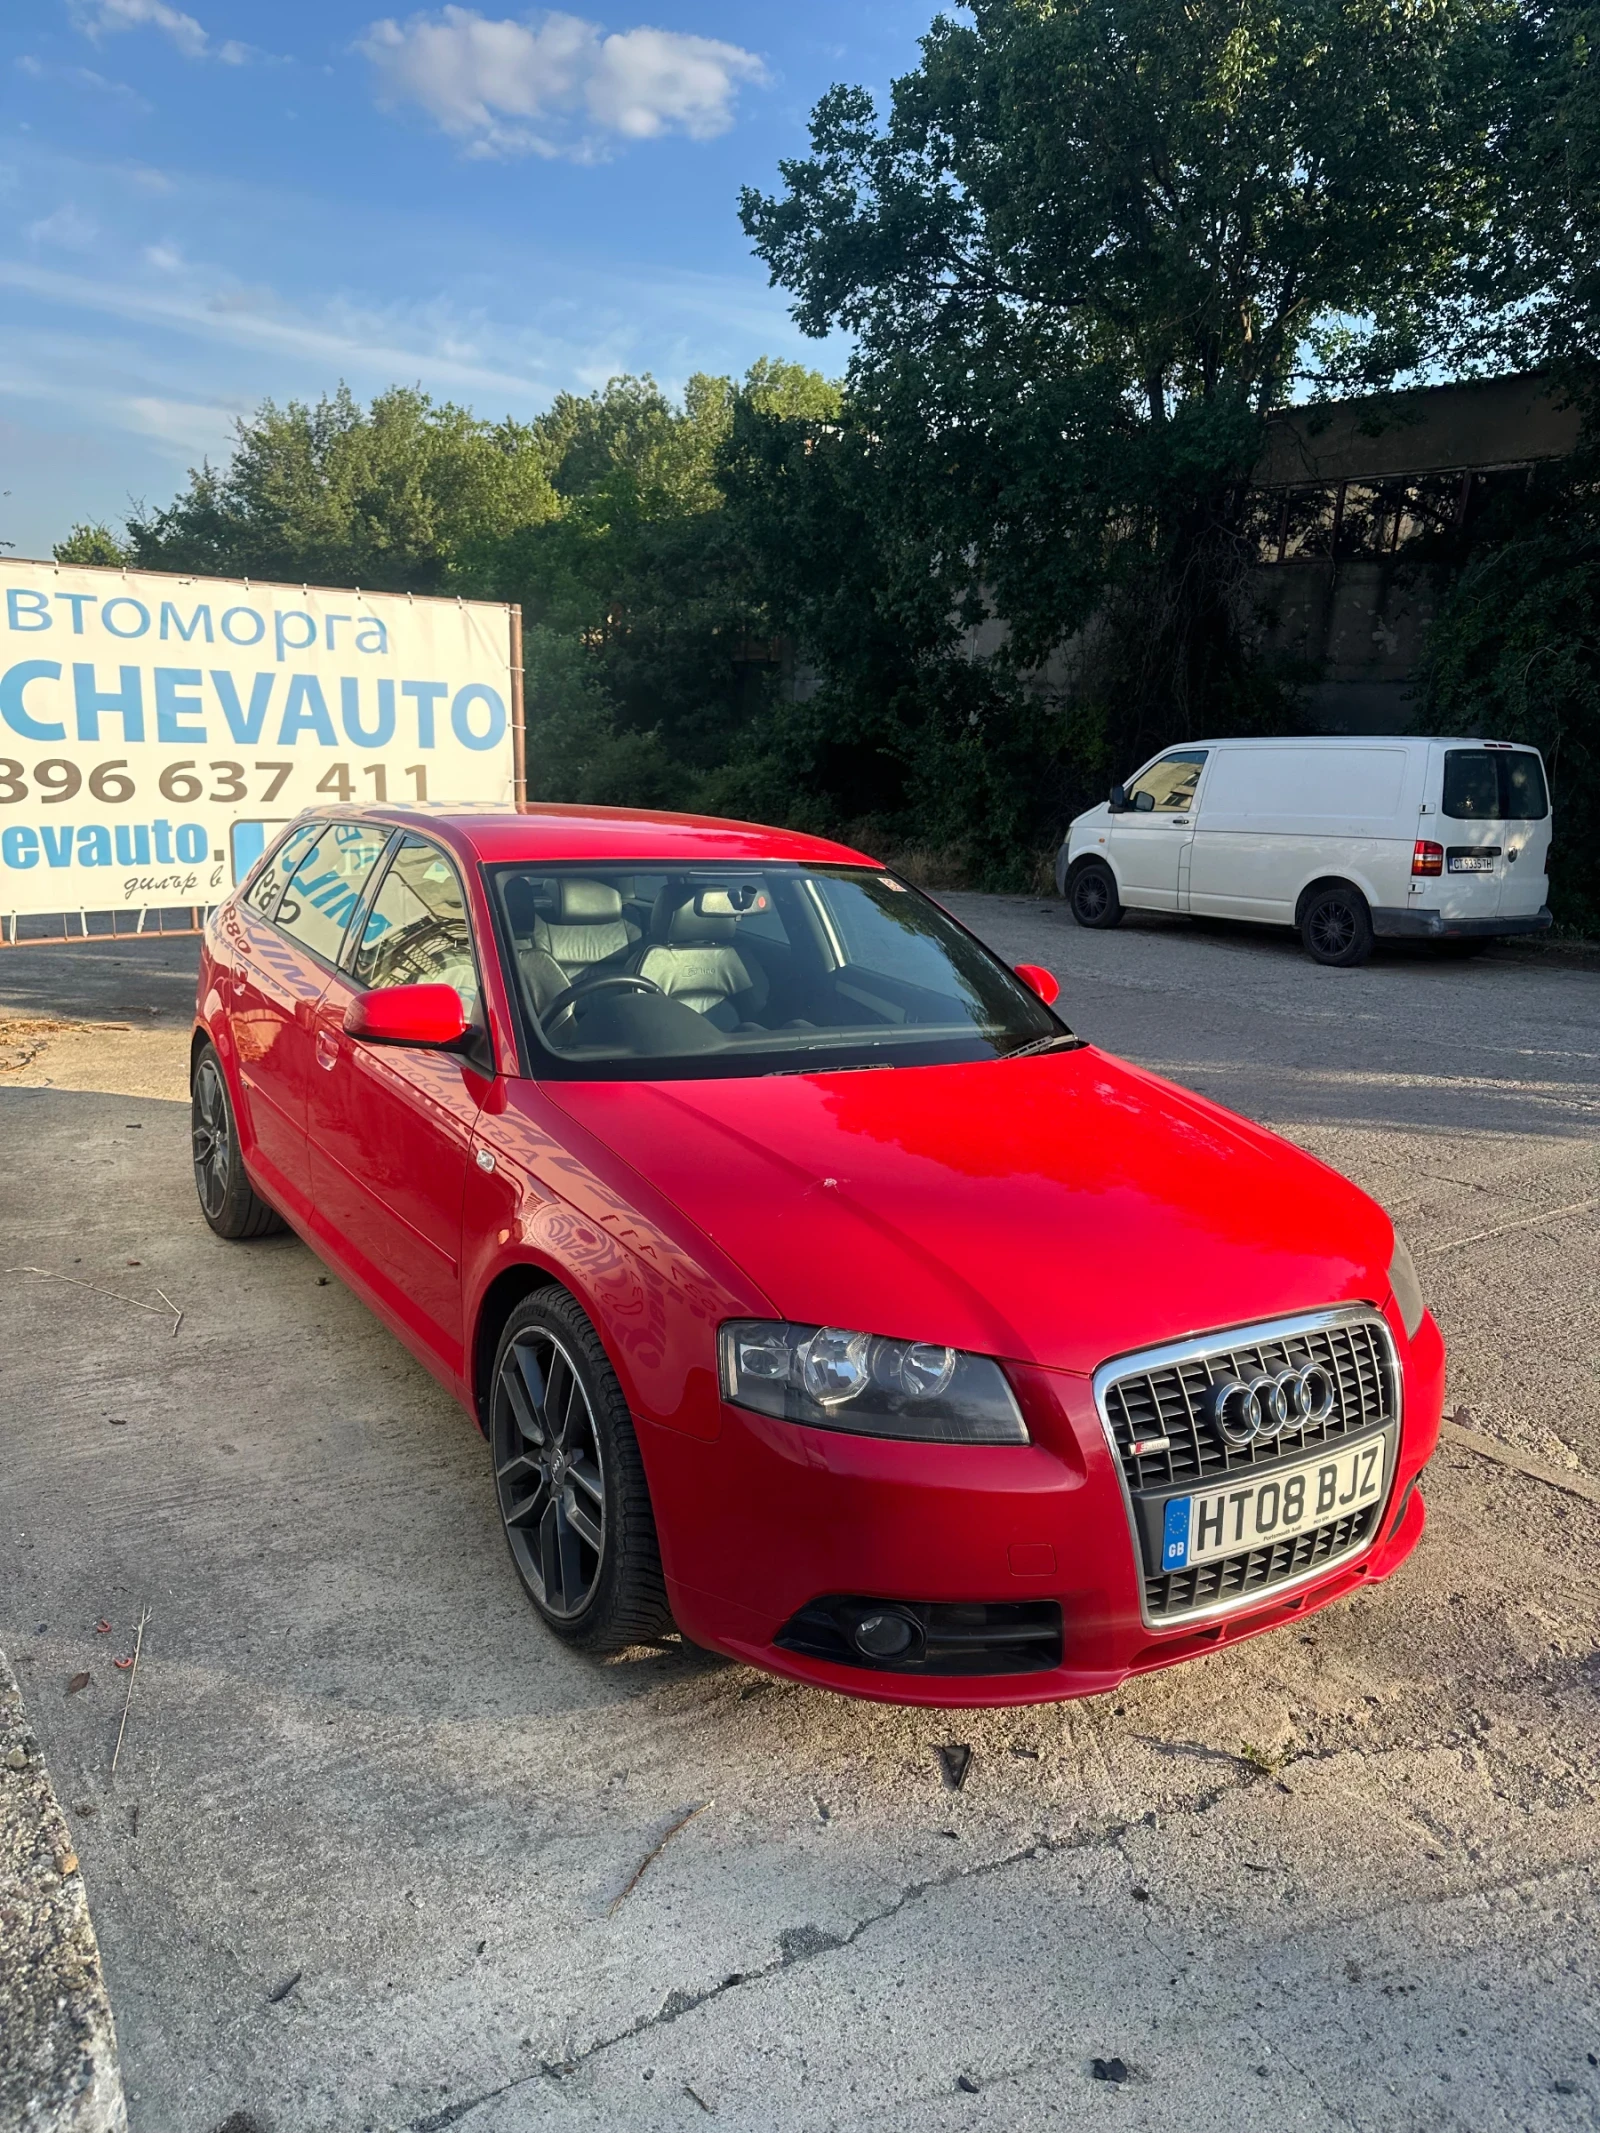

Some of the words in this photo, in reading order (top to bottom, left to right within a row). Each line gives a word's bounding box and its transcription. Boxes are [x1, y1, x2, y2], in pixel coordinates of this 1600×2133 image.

[0, 659, 507, 751] CHEVAUTO
[158, 760, 294, 803] 637
[316, 763, 428, 802] 411
[1482, 858, 1492, 869] TH
[1197, 1474, 1306, 1552] HT08
[1315, 1446, 1379, 1516] BJZ
[1168, 1541, 1185, 1558] GB
